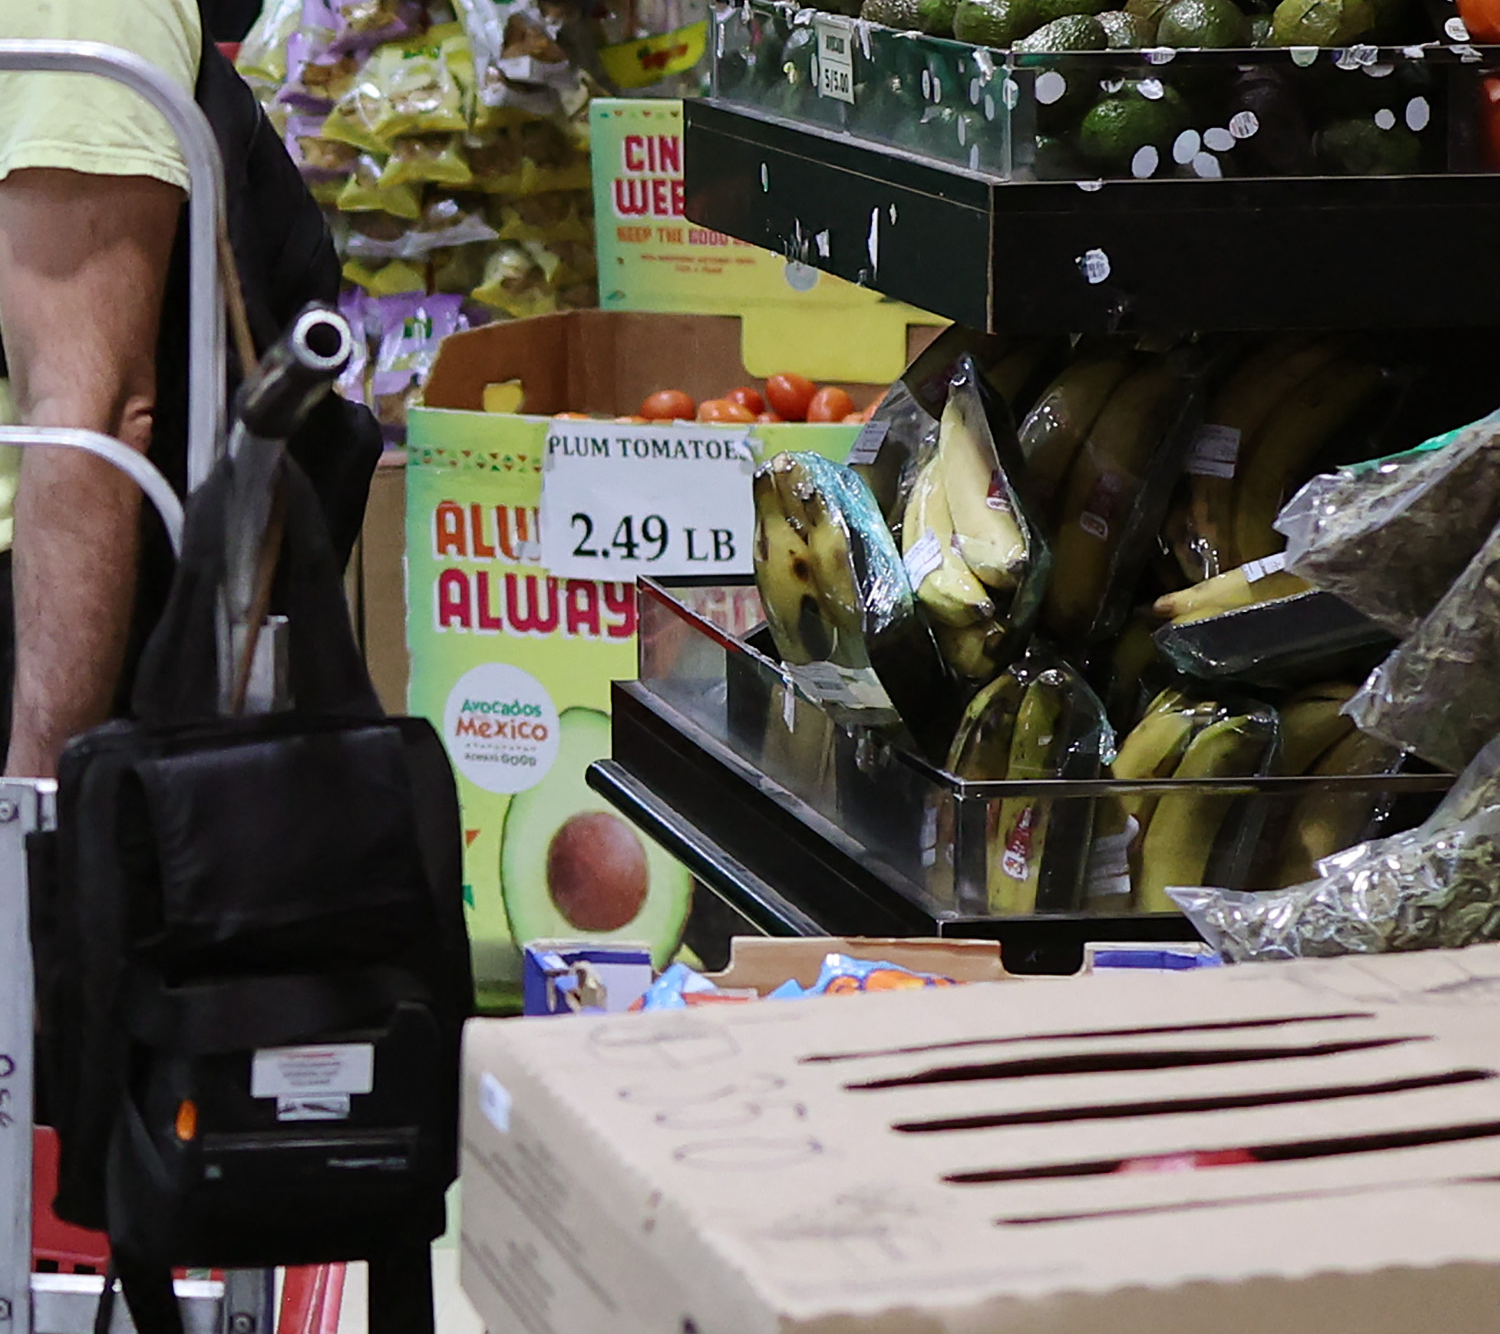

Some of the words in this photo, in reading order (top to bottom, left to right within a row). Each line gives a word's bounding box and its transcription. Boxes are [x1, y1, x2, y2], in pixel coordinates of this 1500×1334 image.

[547, 434, 613, 459] PLUM
[569, 512, 670, 562] 2.49
[685, 527, 740, 563] LB
[460, 696, 543, 720] Avocados
[454, 716, 550, 745] Mexico
